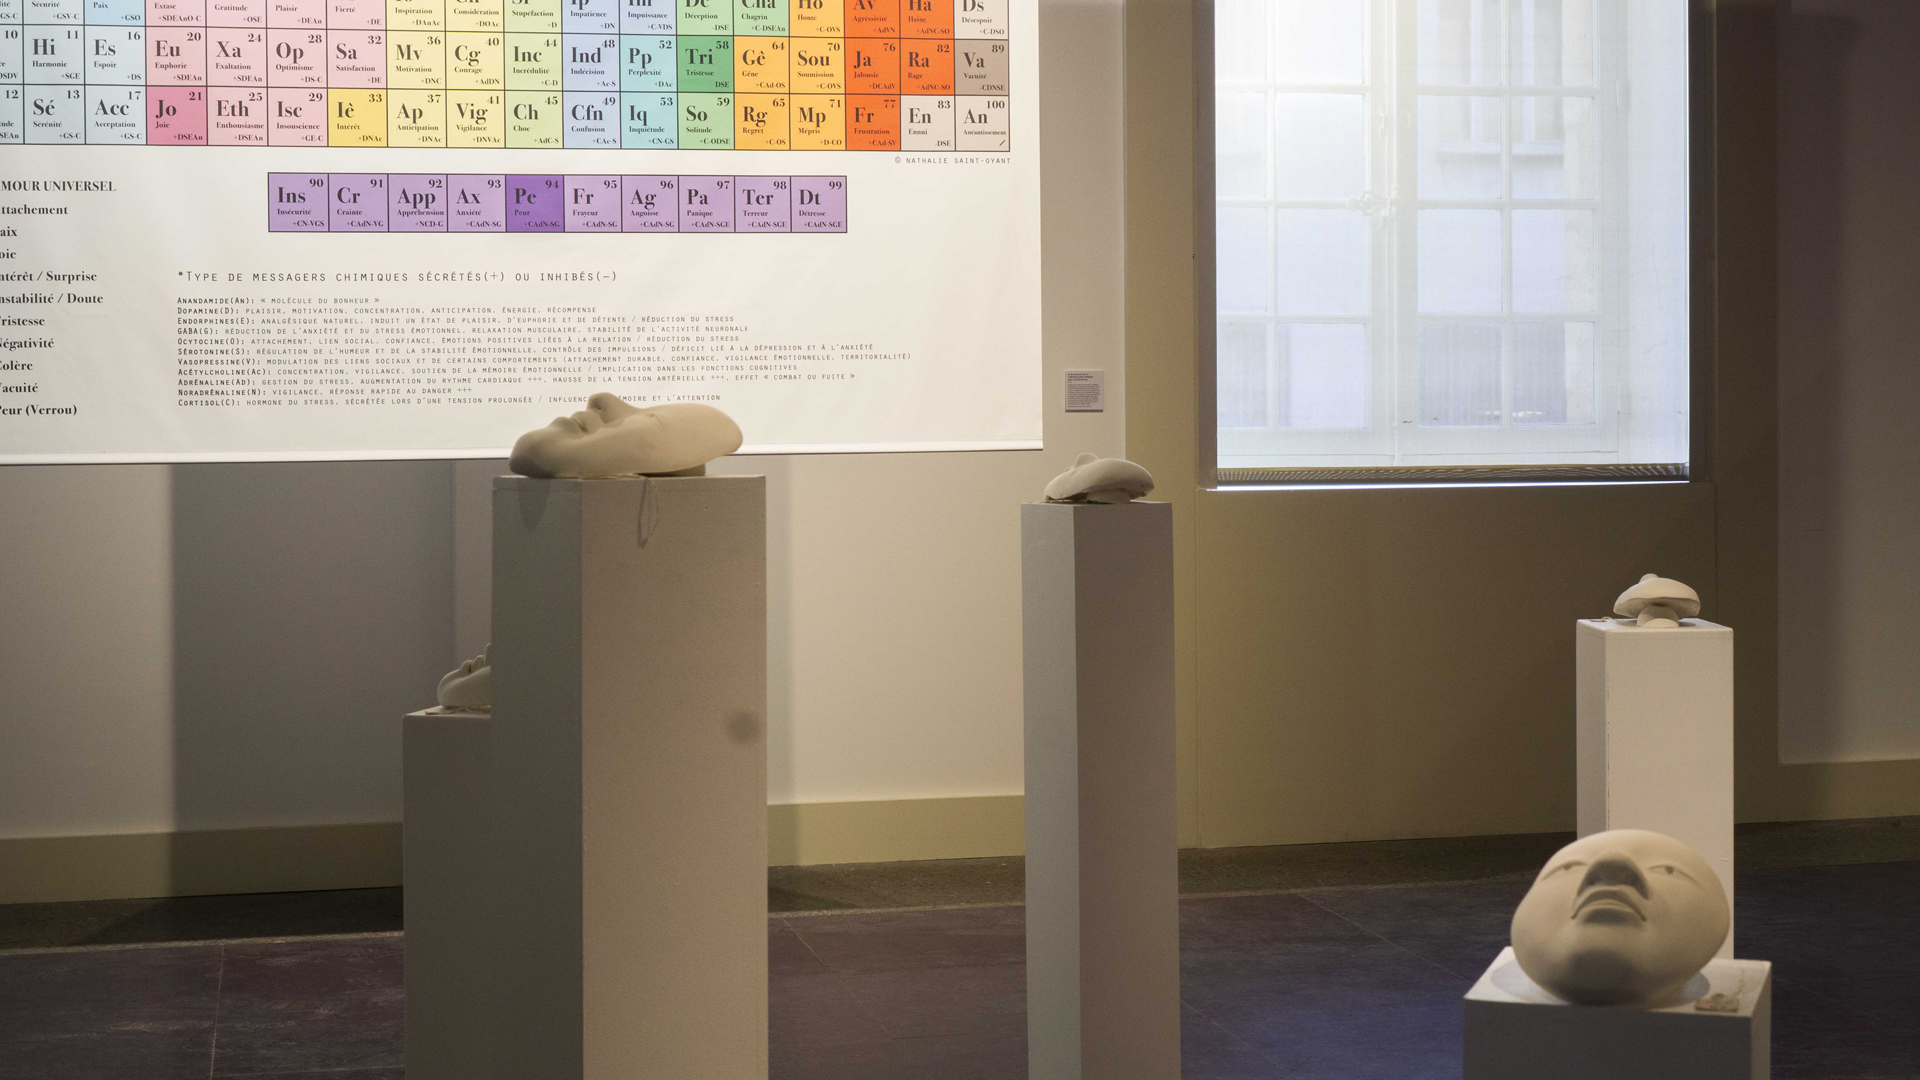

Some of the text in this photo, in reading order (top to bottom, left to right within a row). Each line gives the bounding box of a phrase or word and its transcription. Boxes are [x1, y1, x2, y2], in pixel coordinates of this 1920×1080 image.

[5, 30, 18, 39] 10
[67, 30, 78, 39] 11
[128, 31, 140, 40] 16
[187, 32, 201, 41] 20
[248, 33, 261, 42] 24
[308, 34, 322, 43] 28
[368, 35, 381, 44] 32
[427, 36, 441, 45] 36
[485, 38, 499, 46] 40
[544, 39, 557, 47] 44
[602, 39, 615, 48] 48
[659, 40, 672, 49] 52
[716, 41, 729, 49] 58
[33, 39, 55, 55] Hi
[95, 39, 116, 56] Es
[156, 40, 180, 57] Eu
[217, 41, 241, 58] Xa
[772, 42, 784, 50] 64
[827, 43, 840, 51] 70
[883, 43, 896, 51] 76
[937, 44, 950, 53] 82
[992, 45, 1004, 53] 89
[276, 42, 304, 64] Op
[336, 44, 357, 59] Sa
[396, 44, 422, 60] Mv
[455, 45, 481, 66] Cg
[514, 46, 542, 62] Inc
[572, 47, 601, 63] Ind
[685, 49, 713, 64] Tri
[629, 48, 652, 69] Pp
[798, 51, 829, 66] Sou
[853, 51, 871, 69] Ja
[909, 52, 929, 67] Ra
[964, 52, 985, 68] Va
[94, 61, 117, 69] Espoir
[155, 62, 187, 70] Euphorie
[276, 64, 313, 72] Optimisme
[454, 67, 482, 75] Courage
[628, 68, 661, 77] Perplexité
[853, 71, 879, 79] Jalousie
[908, 72, 923, 80] Rage
[33, 99, 55, 115] Sé
[95, 99, 129, 115] Acc
[155, 100, 177, 119] Jo
[217, 100, 249, 116] Eth
[278, 101, 302, 117] Isc
[514, 104, 538, 120] Ch
[397, 103, 423, 124] Ap
[456, 103, 488, 125] Vig
[572, 105, 603, 120] Cfn
[630, 105, 647, 126] Iq
[686, 106, 707, 121] So
[744, 106, 768, 127] Rg
[799, 107, 826, 128] Mp
[855, 107, 874, 123] Fr
[910, 108, 931, 123] En
[964, 109, 987, 124] An
[94, 121, 136, 129] Acceptation
[155, 121, 170, 129] Joie
[0, 181, 40, 191] MOUR
[309, 179, 324, 187] 90
[370, 179, 382, 188] 91
[428, 179, 442, 188] 92
[487, 180, 501, 188] 93
[545, 180, 559, 189] 94
[604, 180, 617, 189] 95
[660, 181, 674, 189] 96
[717, 181, 730, 189] 97
[773, 181, 787, 189] 98
[829, 181, 842, 189] 99
[278, 187, 306, 203] Ins
[337, 187, 360, 203] Cr
[397, 188, 436, 209] App
[457, 188, 480, 204] Ax
[515, 188, 536, 204] Pe
[574, 188, 594, 204] Fr
[631, 189, 657, 211] Ag
[688, 189, 708, 205] Pa
[743, 189, 774, 205] Ter
[800, 190, 820, 205] Dt
[0, 204, 67, 214] ttachement
[397, 209, 444, 217] Appréhension
[573, 209, 598, 218] Frayeur
[631, 210, 659, 218] Angoisse
[687, 210, 713, 218] Panique
[0, 226, 17, 236] aix
[0, 249, 16, 259] oie
[0, 293, 54, 303] nstabilité
[0, 316, 45, 326] ristesse
[0, 338, 54, 351] égativité
[0, 382, 38, 393] acuité
[0, 405, 22, 415] eur
